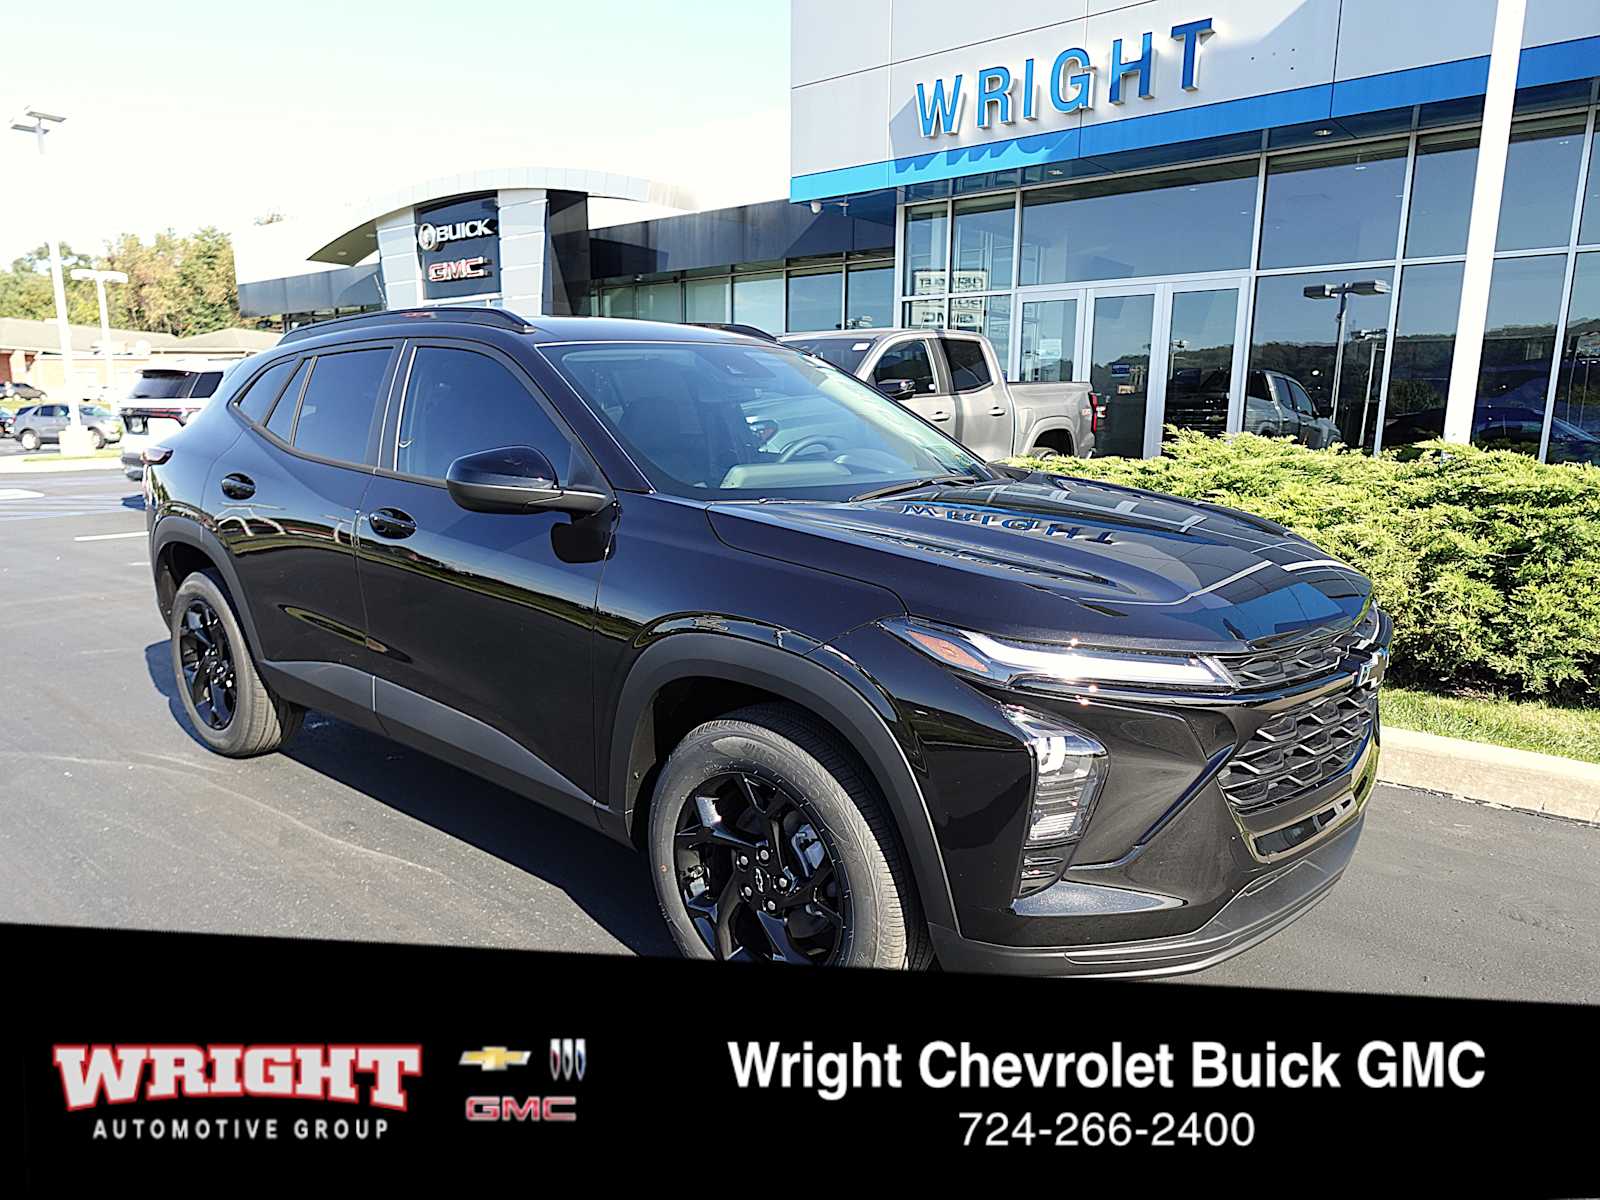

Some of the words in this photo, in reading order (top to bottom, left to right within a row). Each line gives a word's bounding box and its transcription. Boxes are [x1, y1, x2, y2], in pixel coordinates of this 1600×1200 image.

[915, 17, 1215, 138] WRIGHT
[435, 218, 494, 242] BUICK
[428, 256, 485, 282] GMC
